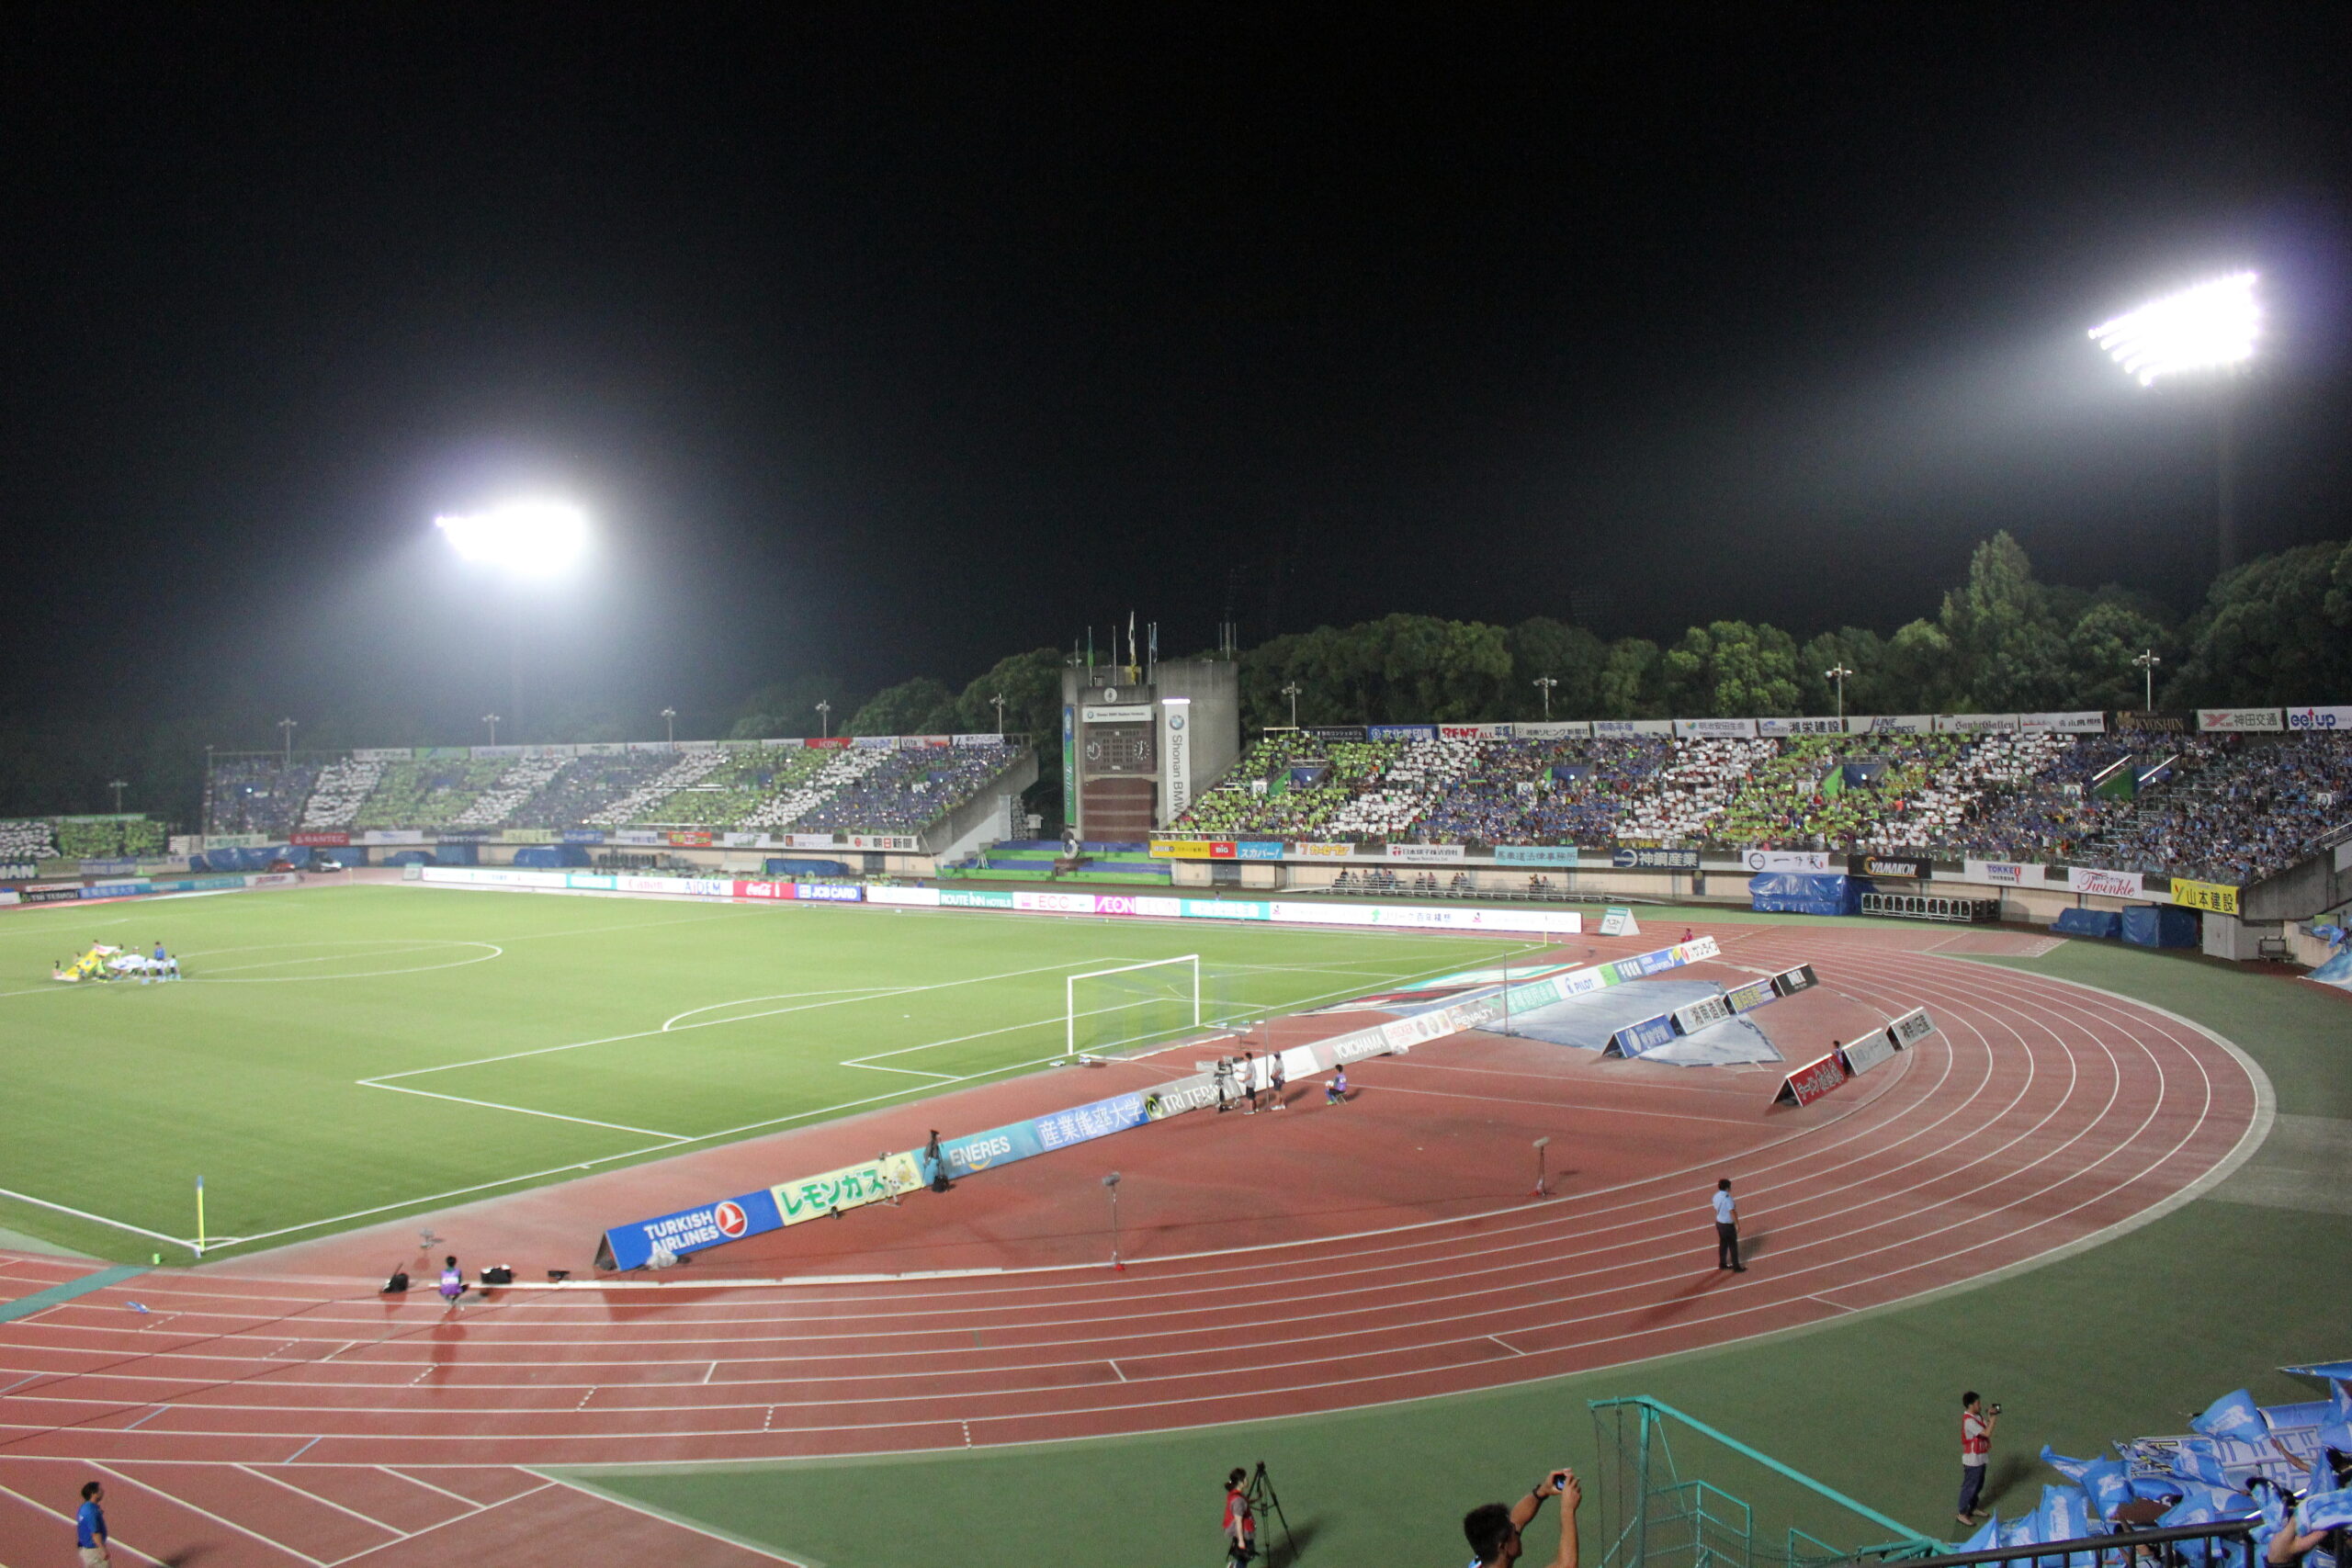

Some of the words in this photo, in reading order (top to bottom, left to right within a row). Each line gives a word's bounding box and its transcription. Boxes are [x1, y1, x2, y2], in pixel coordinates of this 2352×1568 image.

[2233, 713, 2278, 727] 神田交通
[1172, 734, 1183, 777] Shonan
[1173, 781, 1185, 814] BMW
[873, 837, 913, 849] 朝日新聞
[831, 886, 857, 899] CARD
[2077, 872, 2135, 897] Twinkle
[941, 894, 969, 905] ROUTE
[987, 898, 1012, 908] HOTELS
[1038, 896, 1069, 908] ECC
[2187, 888, 2234, 913] 山本建設
[1574, 980, 1595, 993] PILOT
[1453, 1007, 1495, 1027] PENALTY
[1332, 1033, 1387, 1060] YOKOHAMA
[1038, 1097, 1144, 1146] 産業能率大学
[948, 1135, 1011, 1167] ENERES
[781, 1168, 886, 1216] レモンガス
[643, 1210, 715, 1240] TURKISH
[651, 1225, 720, 1256] AIRLINES
